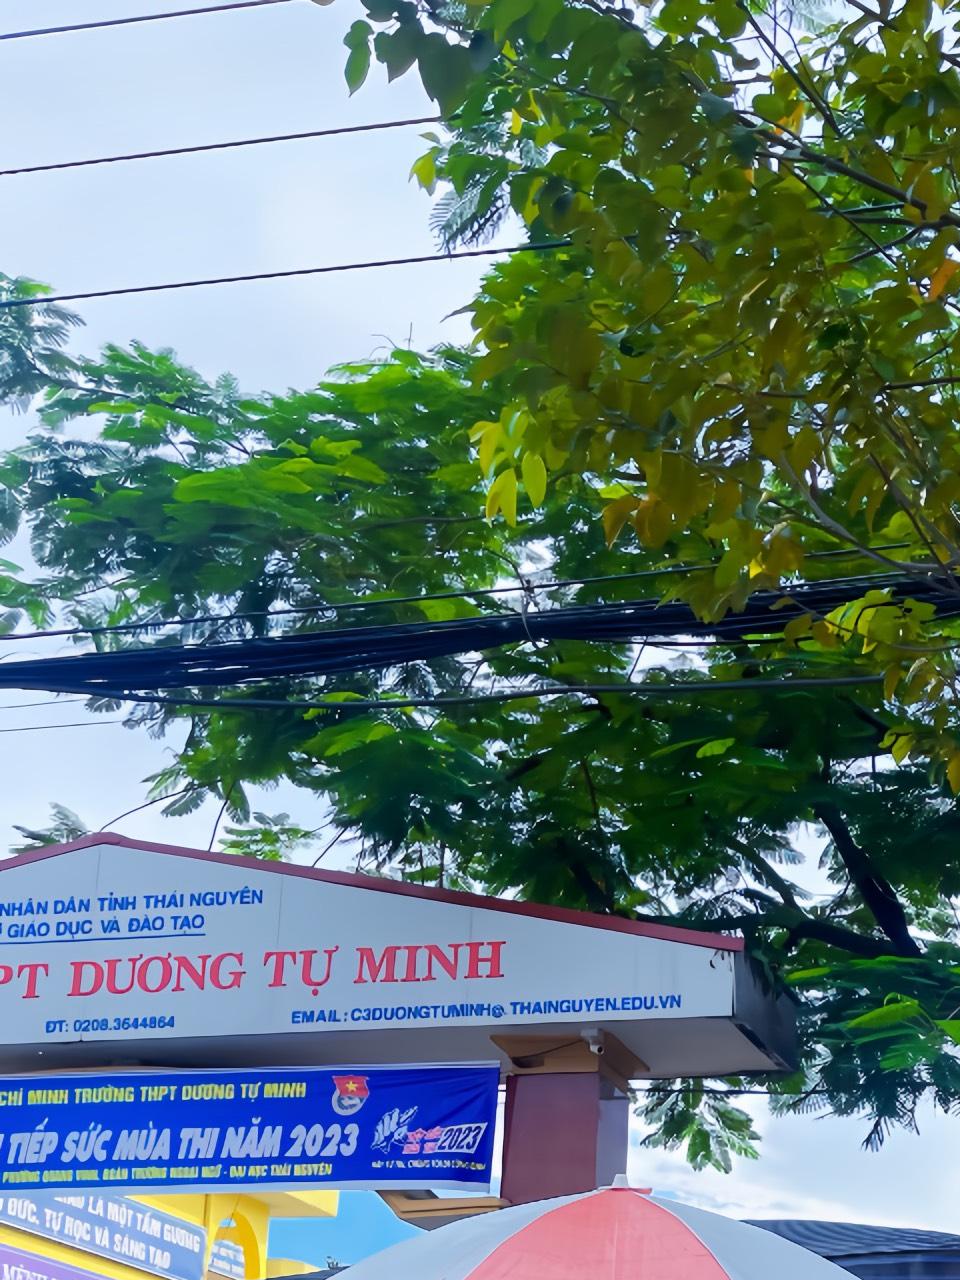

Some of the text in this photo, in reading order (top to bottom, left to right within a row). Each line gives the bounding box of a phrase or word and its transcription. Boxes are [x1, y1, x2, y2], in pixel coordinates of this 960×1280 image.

[53, 896, 91, 914] DÂN
[98, 892, 137, 911] TỈNH
[143, 891, 184, 909] THÁI
[189, 886, 263, 907] NGUYÊN
[7, 914, 205, 940] GIÁO DỤC VÀ ĐÀO TẠO
[66, 952, 247, 997] DƯƠNG
[263, 945, 339, 997] TỰ
[354, 941, 506, 984] MINH
[45, 1020, 69, 1034] ĐT:
[27, 1089, 69, 1105] MINH
[74, 1083, 135, 1104] TRƯỜNG
[140, 1085, 177, 1102] THPT
[181, 1083, 235, 1101] DƯƠNG
[240, 1081, 261, 1102] TỰ
[264, 1082, 307, 1099] MINH
[7, 1117, 58, 1164] TIẾP
[61, 1121, 112, 1163] SỨC
[112, 1121, 170, 1161] MÙA
[178, 1127, 220, 1160] THI
[220, 1116, 282, 1159] NĂM
[284, 1123, 359, 1157] 2023
